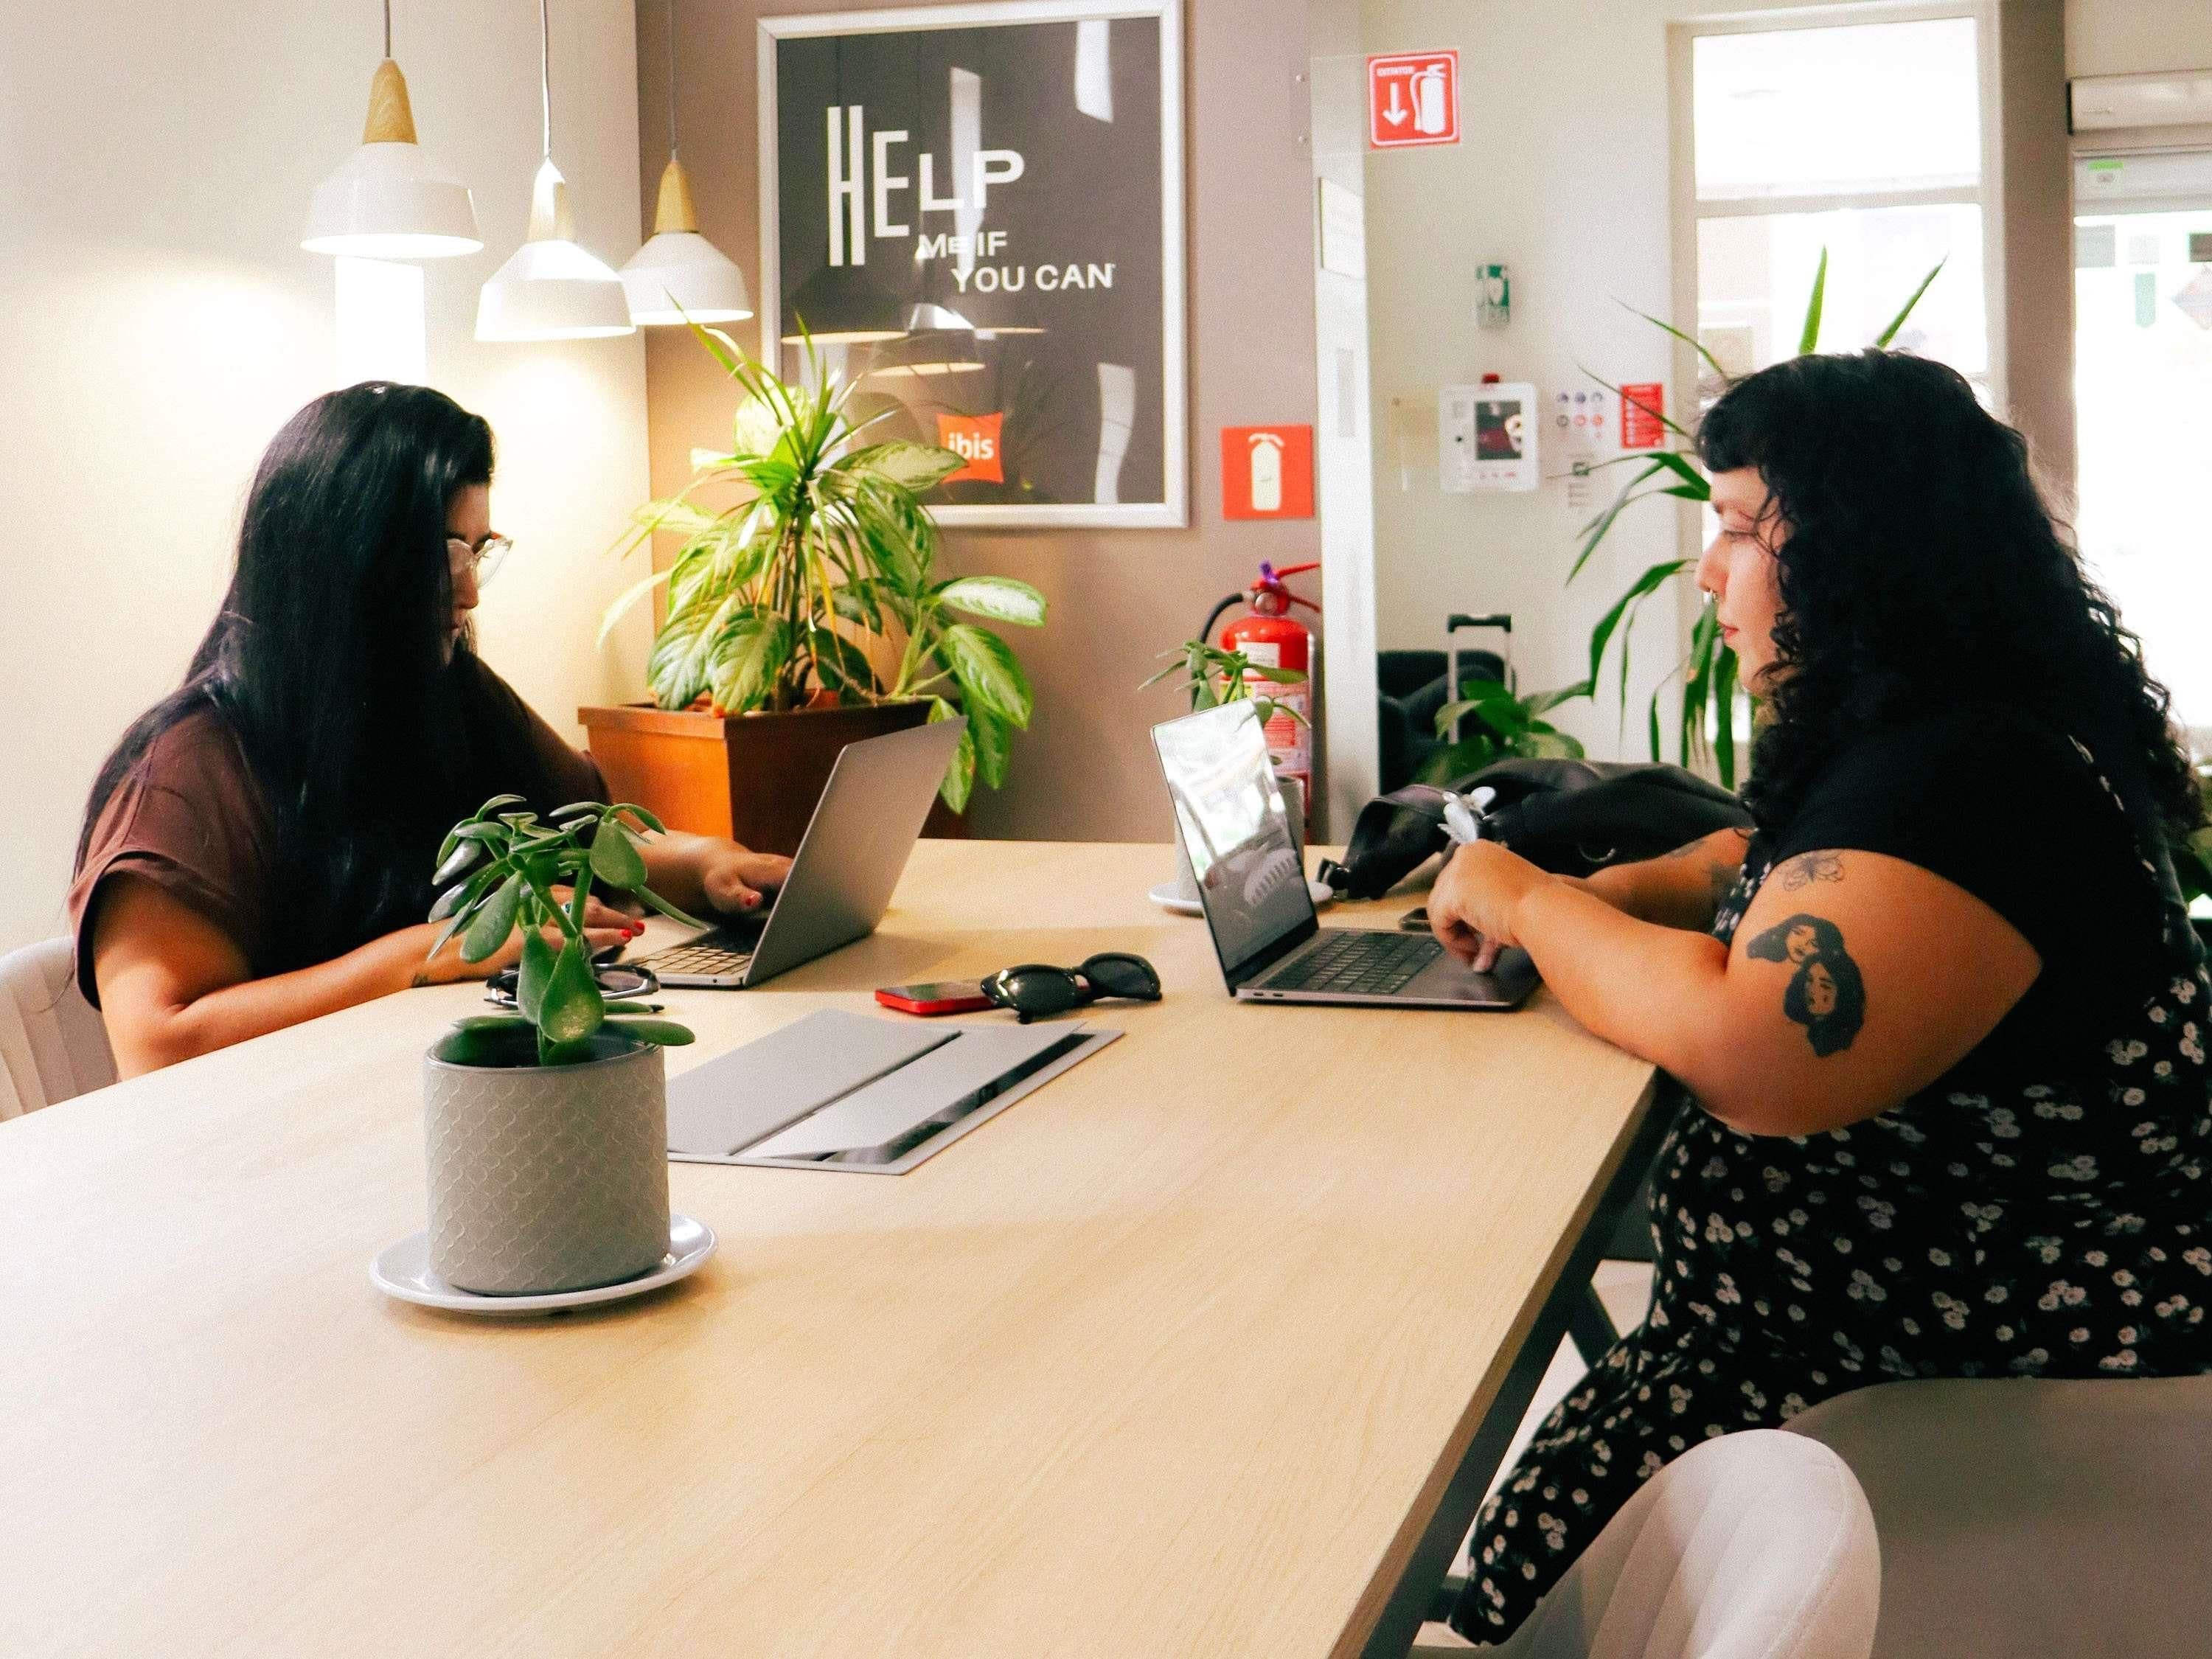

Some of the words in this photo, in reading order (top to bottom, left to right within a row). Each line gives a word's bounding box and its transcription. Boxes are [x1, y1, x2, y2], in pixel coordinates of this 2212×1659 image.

[827, 105, 1024, 266] HELP
[919, 233, 968, 258] ME
[977, 231, 1007, 257] IF
[950, 265, 1025, 293] YOU
[948, 431, 994, 460] ibis
